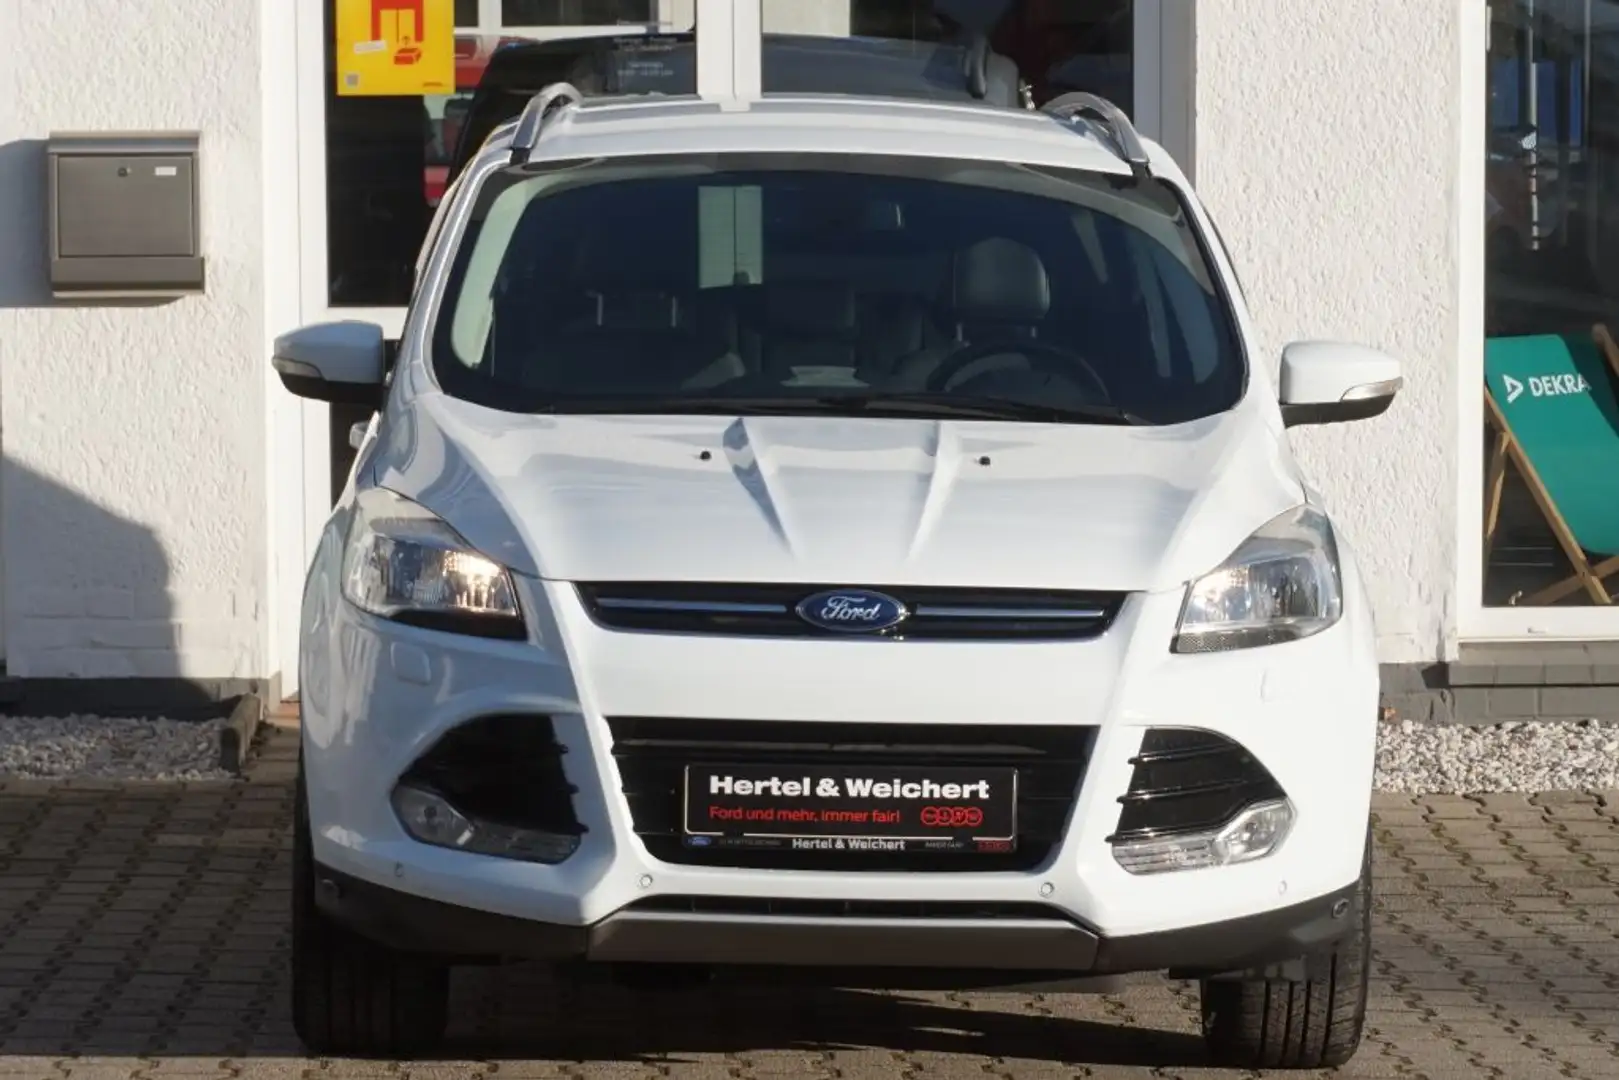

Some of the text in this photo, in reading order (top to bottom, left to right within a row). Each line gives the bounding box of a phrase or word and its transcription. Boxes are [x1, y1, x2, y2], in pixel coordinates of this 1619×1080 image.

[1528, 373, 1592, 397] DEKRA
[820, 595, 882, 621] Ford
[709, 775, 990, 799] Hertel & Weichert
[709, 806, 900, 823] Ford und mehr, immer fair!
[792, 838, 833, 849] Hertel
[834, 838, 845, 849] &
[847, 838, 906, 851] Weichert
